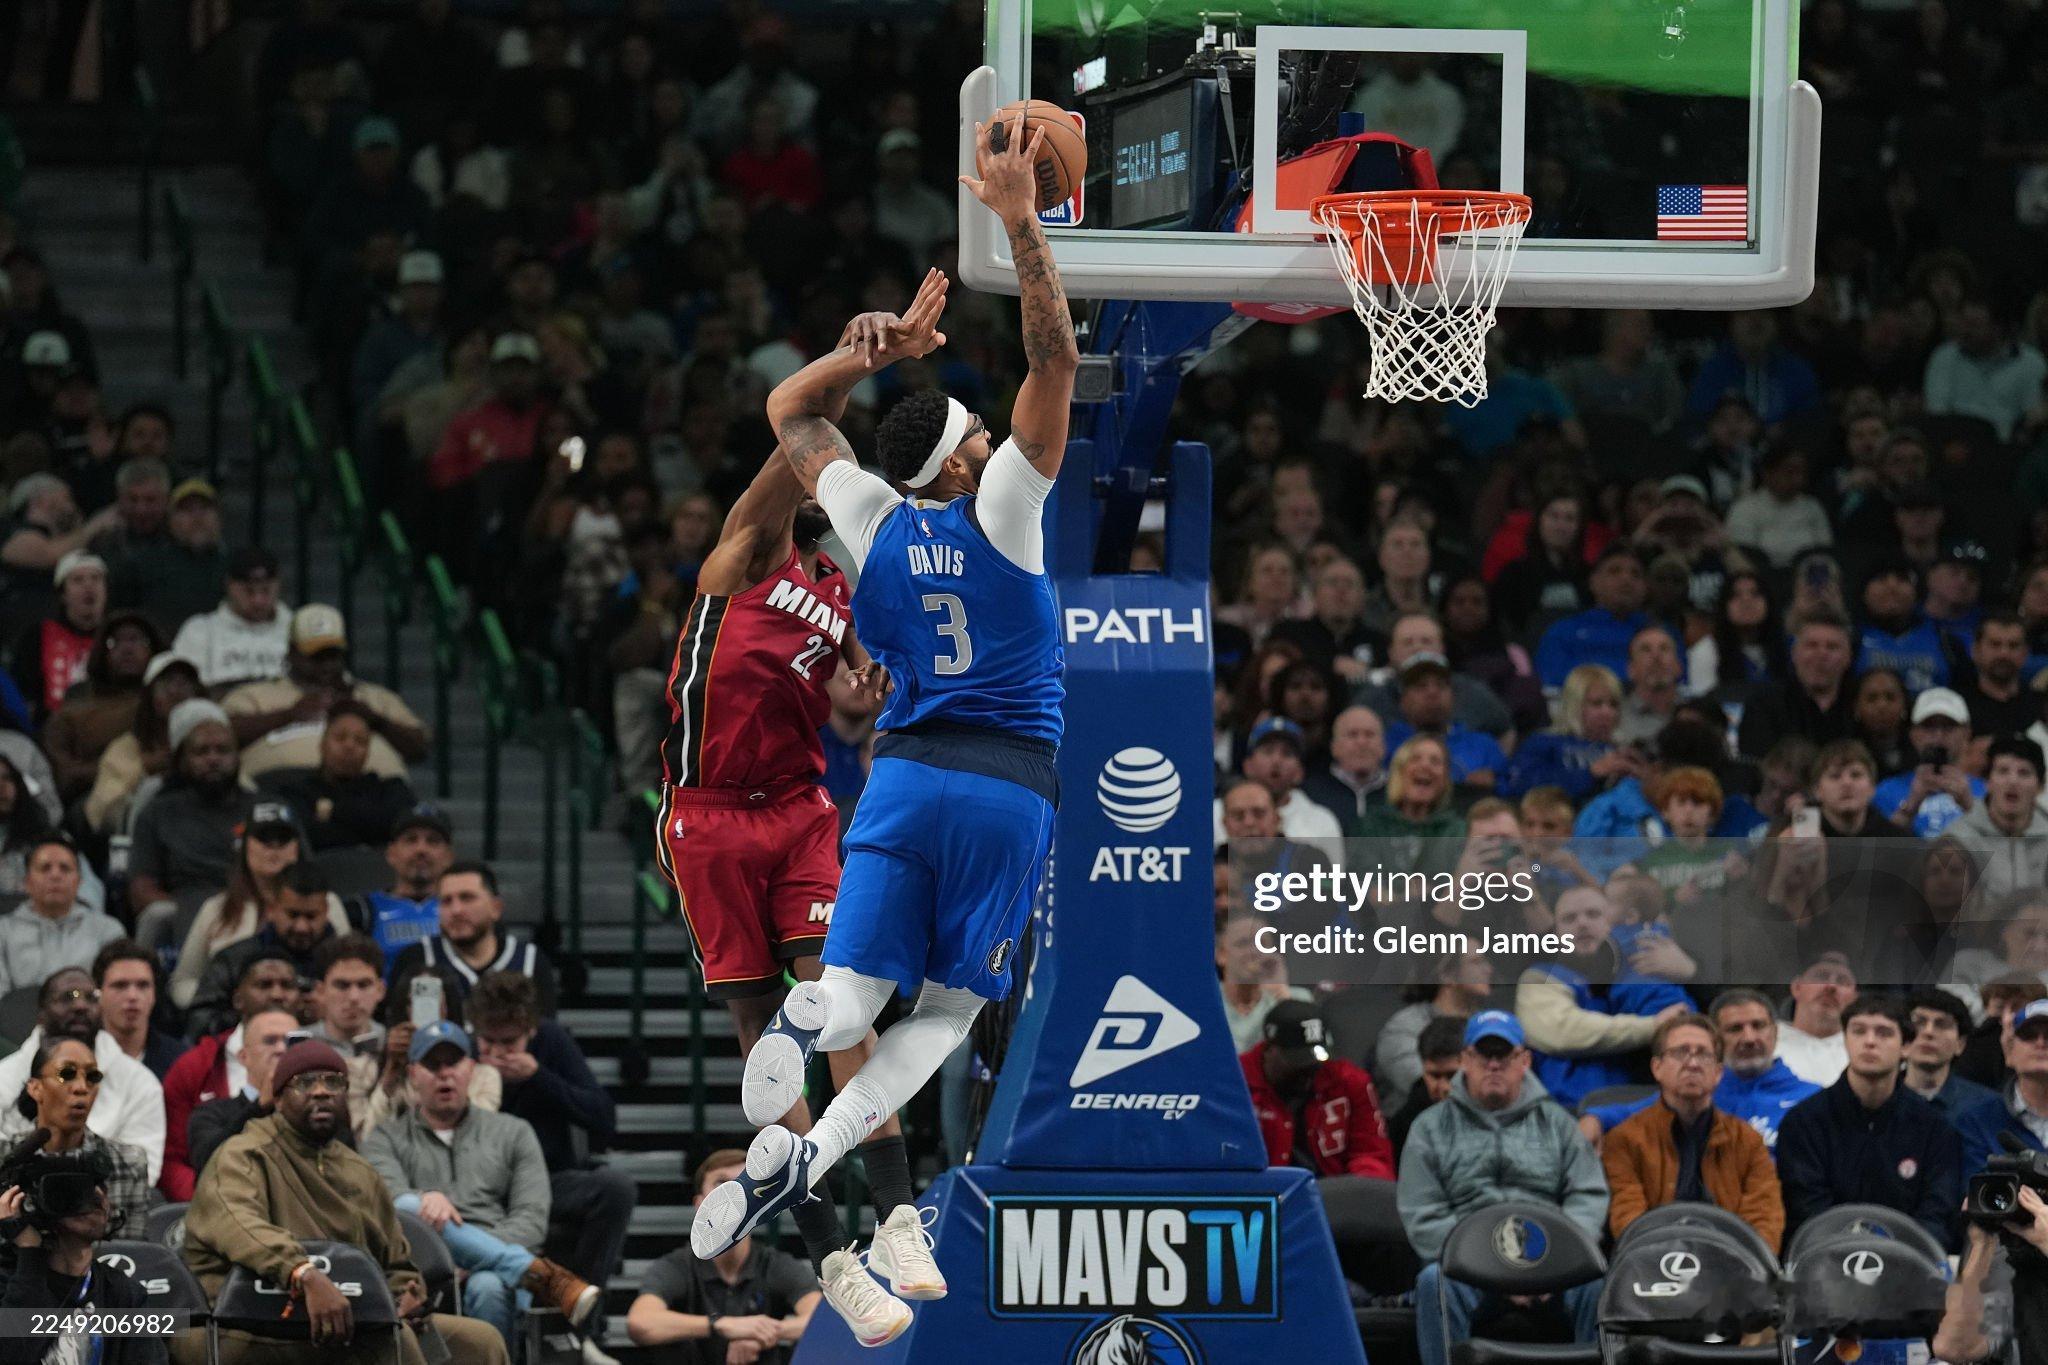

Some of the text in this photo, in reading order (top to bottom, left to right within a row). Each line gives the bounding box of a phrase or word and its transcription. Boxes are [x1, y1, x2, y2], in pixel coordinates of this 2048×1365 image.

[907, 544, 964, 577] DAVIS
[766, 579, 847, 646] MIAM
[1065, 607, 1204, 644] PATH
[921, 593, 973, 675] 3
[790, 634, 833, 681] 22
[1088, 846, 1191, 882] AT&T
[1070, 1093, 1201, 1111] DENAGO
[1163, 1110, 1187, 1121] EV
